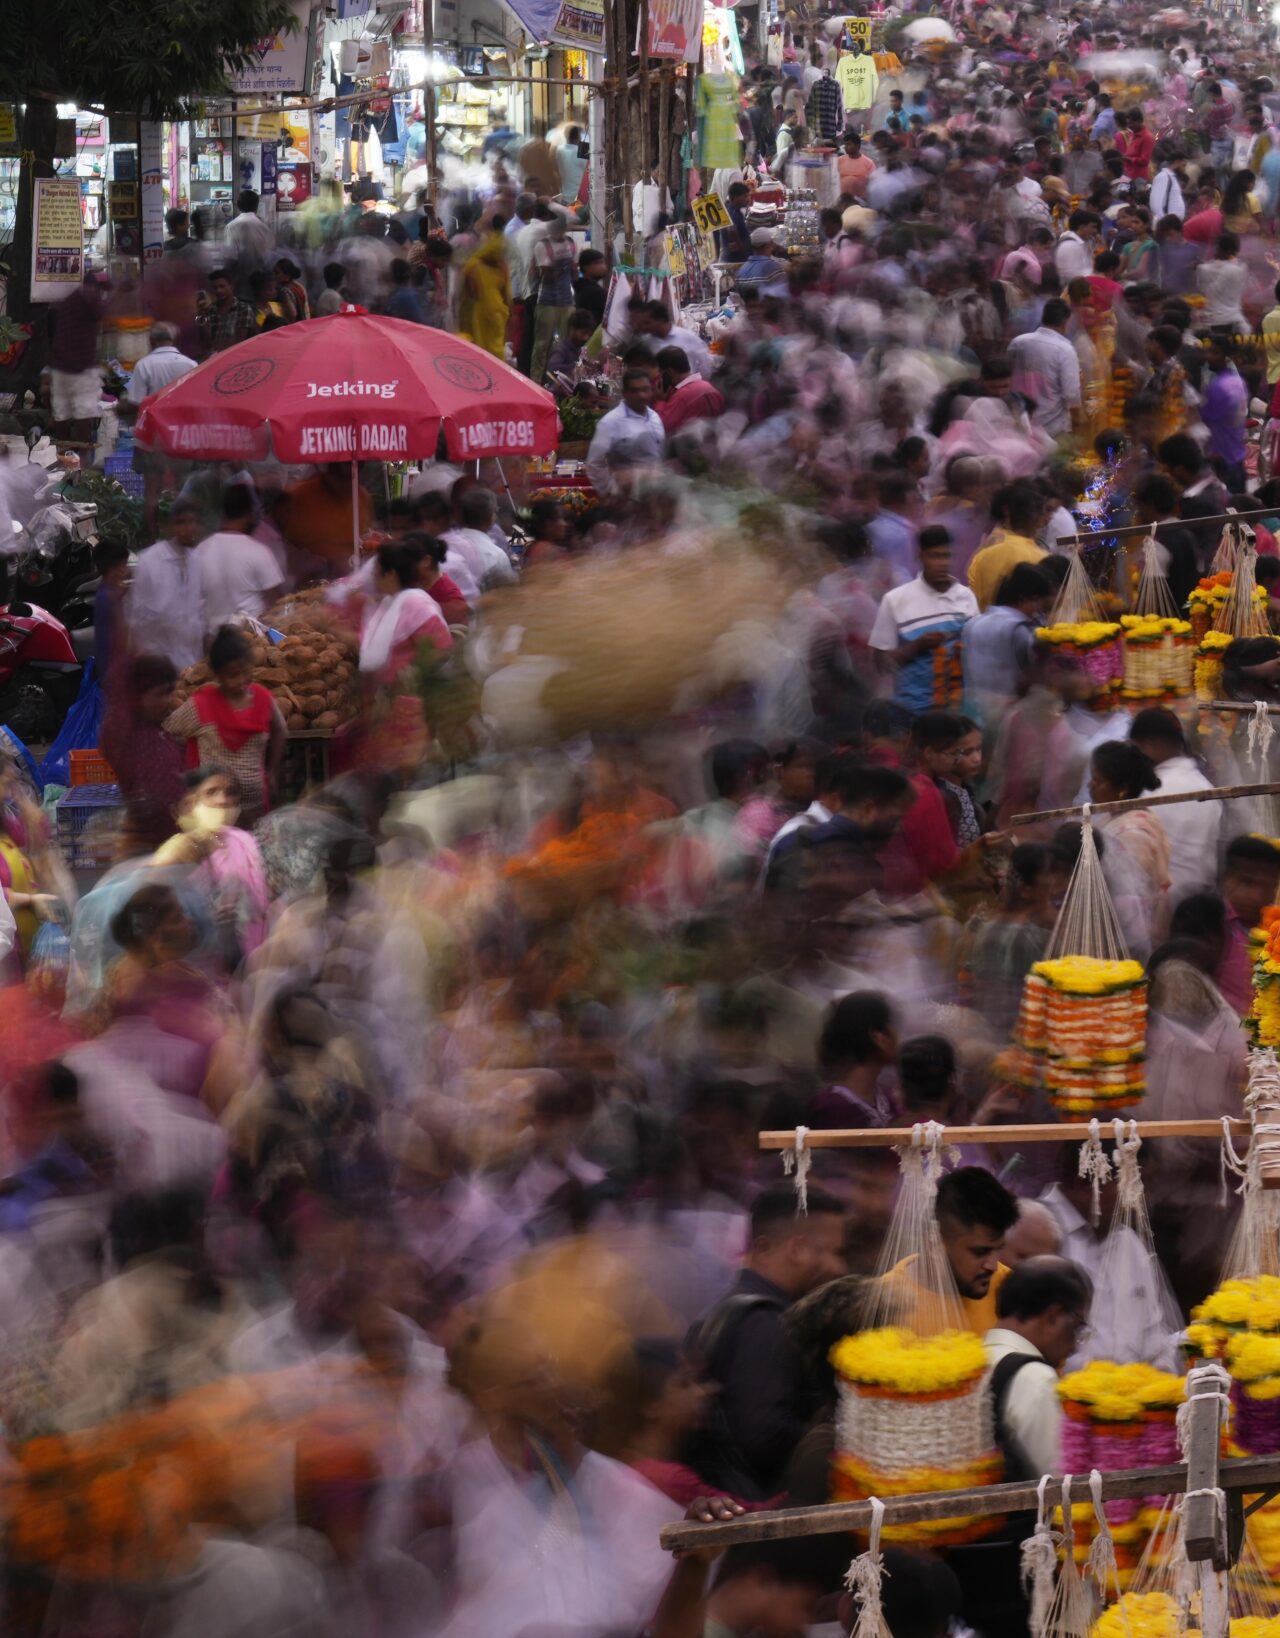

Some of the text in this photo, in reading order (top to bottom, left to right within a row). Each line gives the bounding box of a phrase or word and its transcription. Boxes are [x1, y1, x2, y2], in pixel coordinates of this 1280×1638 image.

[850, 21, 866, 34] 50
[696, 202, 721, 231] 50
[300, 423, 408, 456] JETKING DADAR
